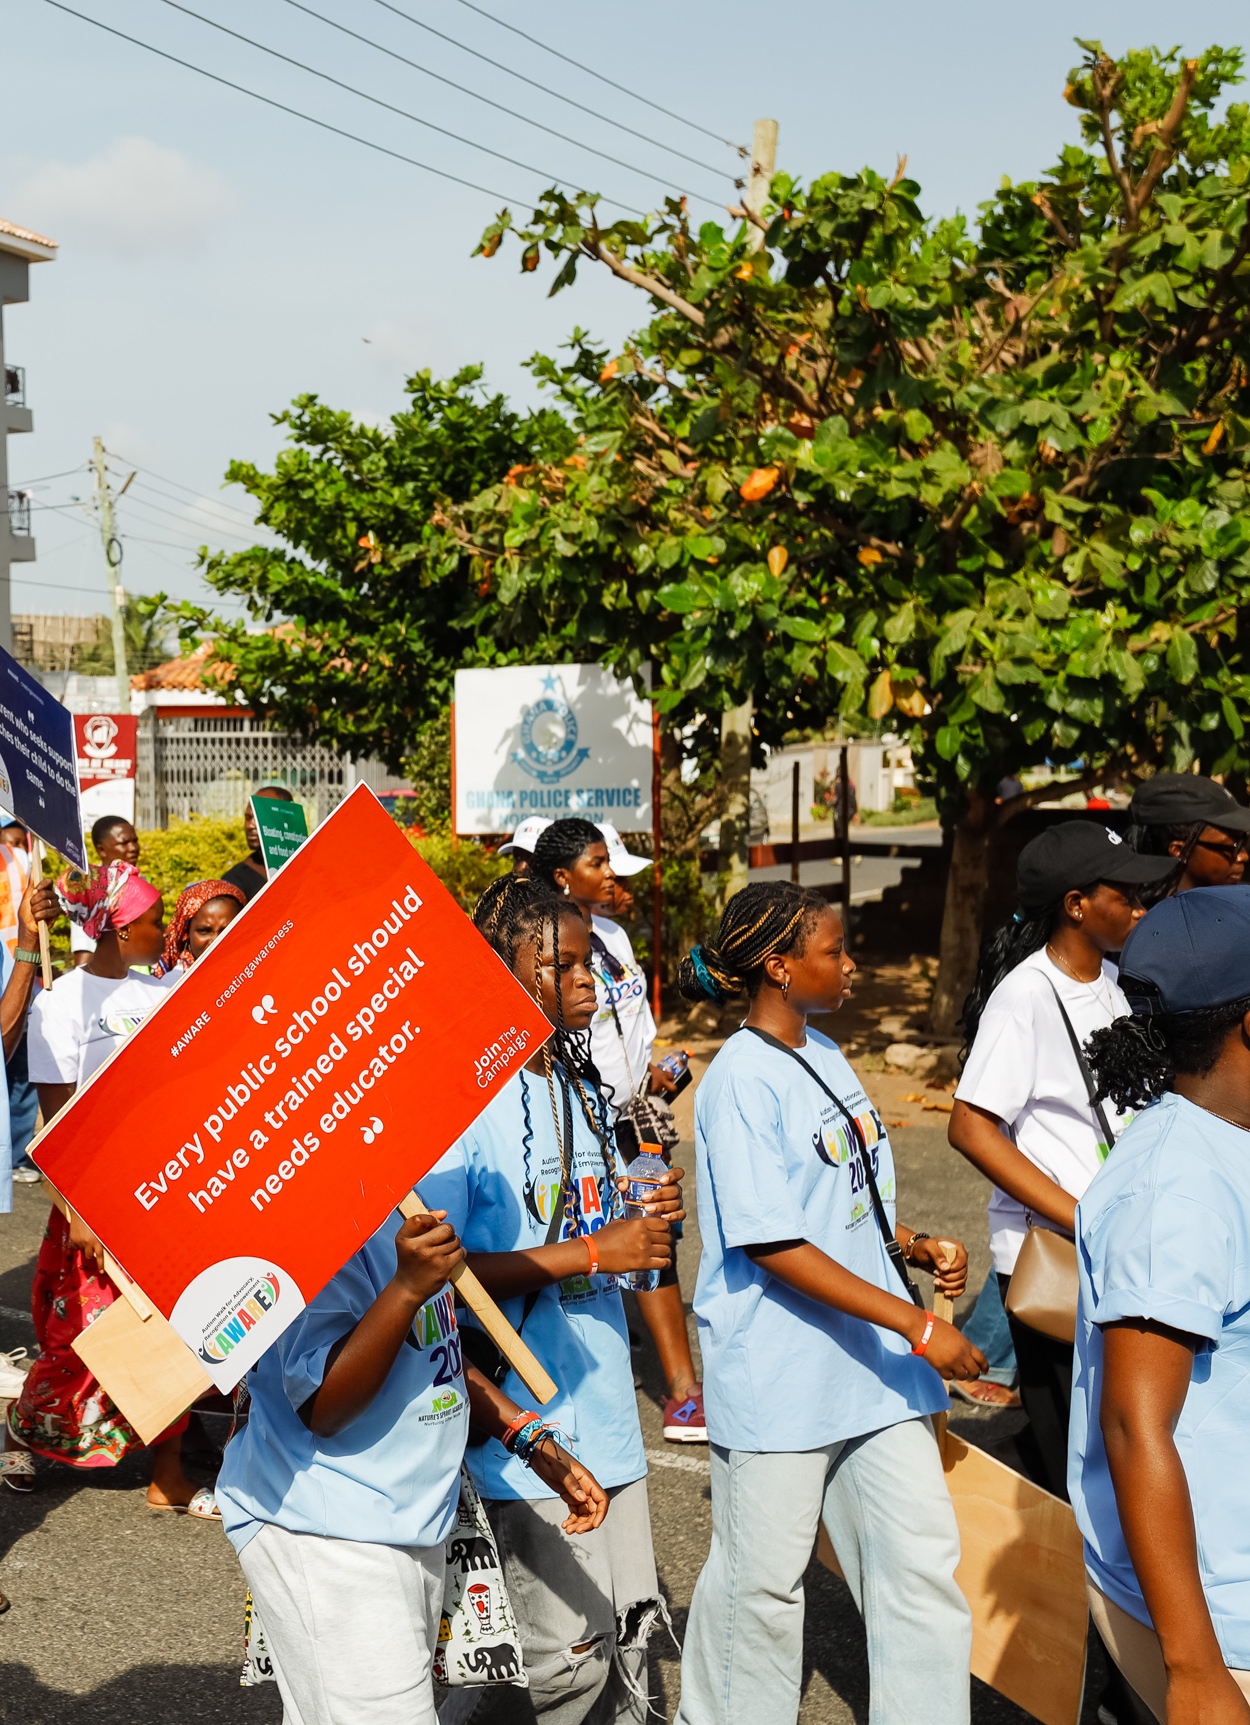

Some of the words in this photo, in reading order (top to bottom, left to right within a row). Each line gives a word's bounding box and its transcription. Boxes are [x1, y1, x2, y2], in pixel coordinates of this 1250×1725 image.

[15, 716, 29, 737] who
[30, 729, 48, 752] seeks
[14, 736, 30, 759] their
[31, 751, 47, 774] child
[47, 764, 55, 780] to
[56, 771, 65, 788] do
[65, 775, 77, 797] the
[25, 768, 46, 793] same.
[466, 789, 516, 809] GHANA
[519, 789, 571, 808] POLICE
[576, 787, 641, 807] SERVICE
[170, 1010, 211, 1058] #AWARE
[215, 919, 294, 1008] creatingawareness
[133, 1132, 205, 1211] Every
[203, 1054, 277, 1143] public
[274, 967, 352, 1058] school
[347, 884, 424, 977] should
[473, 1042, 502, 1076] Join
[498, 1026, 517, 1045] The
[477, 1029, 531, 1088] Campaign
[187, 1148, 250, 1214] have
[248, 1129, 270, 1151] a
[263, 1032, 349, 1130] trained
[345, 946, 425, 1042] special
[249, 1131, 320, 1212] needs
[319, 1020, 421, 1134] educator.
[541, 1165, 562, 1175] Recogni
[202, 1315, 217, 1334] Autism
[215, 1305, 227, 1318] Walk
[225, 1299, 233, 1307] for
[204, 1315, 229, 1341] Recognition
[231, 1279, 261, 1312] Empowerment
[215, 1289, 273, 1356] AWARE
[418, 1413, 440, 1422] NATURE'S
